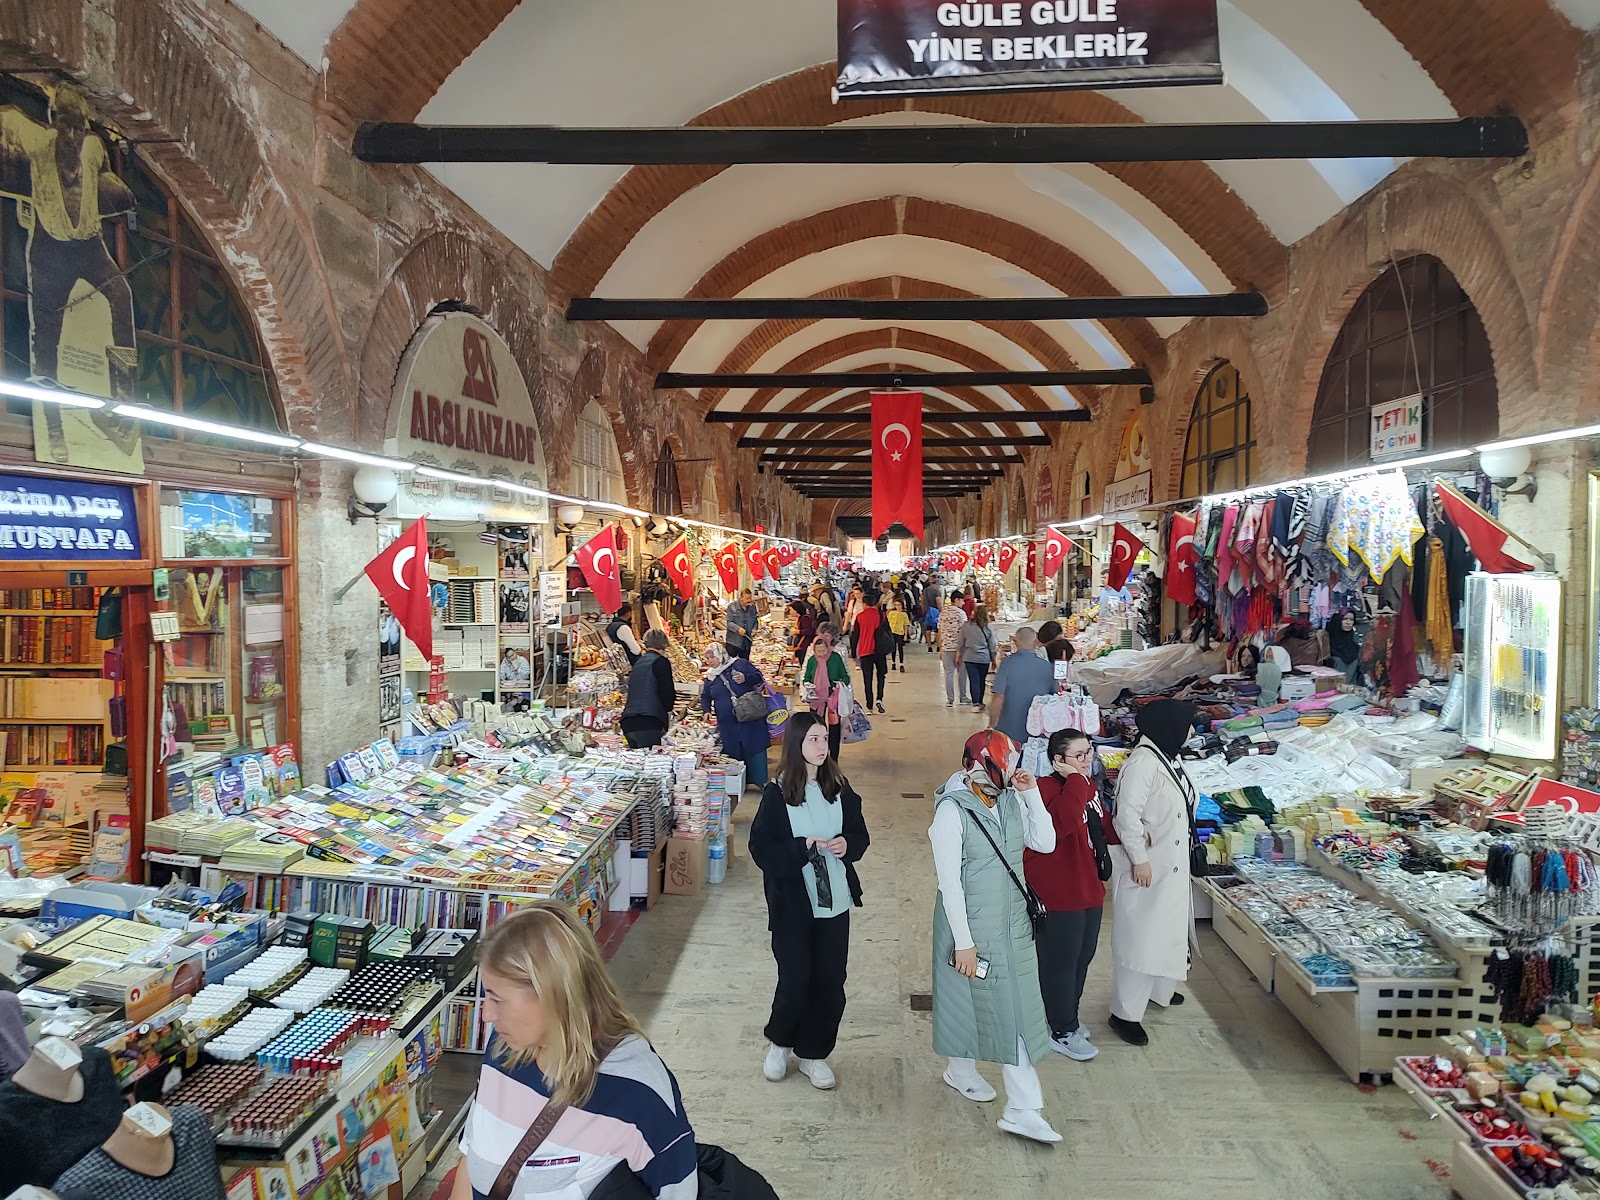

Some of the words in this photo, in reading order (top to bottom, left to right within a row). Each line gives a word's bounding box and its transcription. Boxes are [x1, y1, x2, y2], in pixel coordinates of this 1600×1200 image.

[937, 0, 1023, 27] GÜLE
[907, 31, 984, 63] YİNE
[992, 26, 1149, 61] BEKLERİZ
[410, 390, 537, 465] ARSLANZADE
[1373, 400, 1419, 433] TETİK
